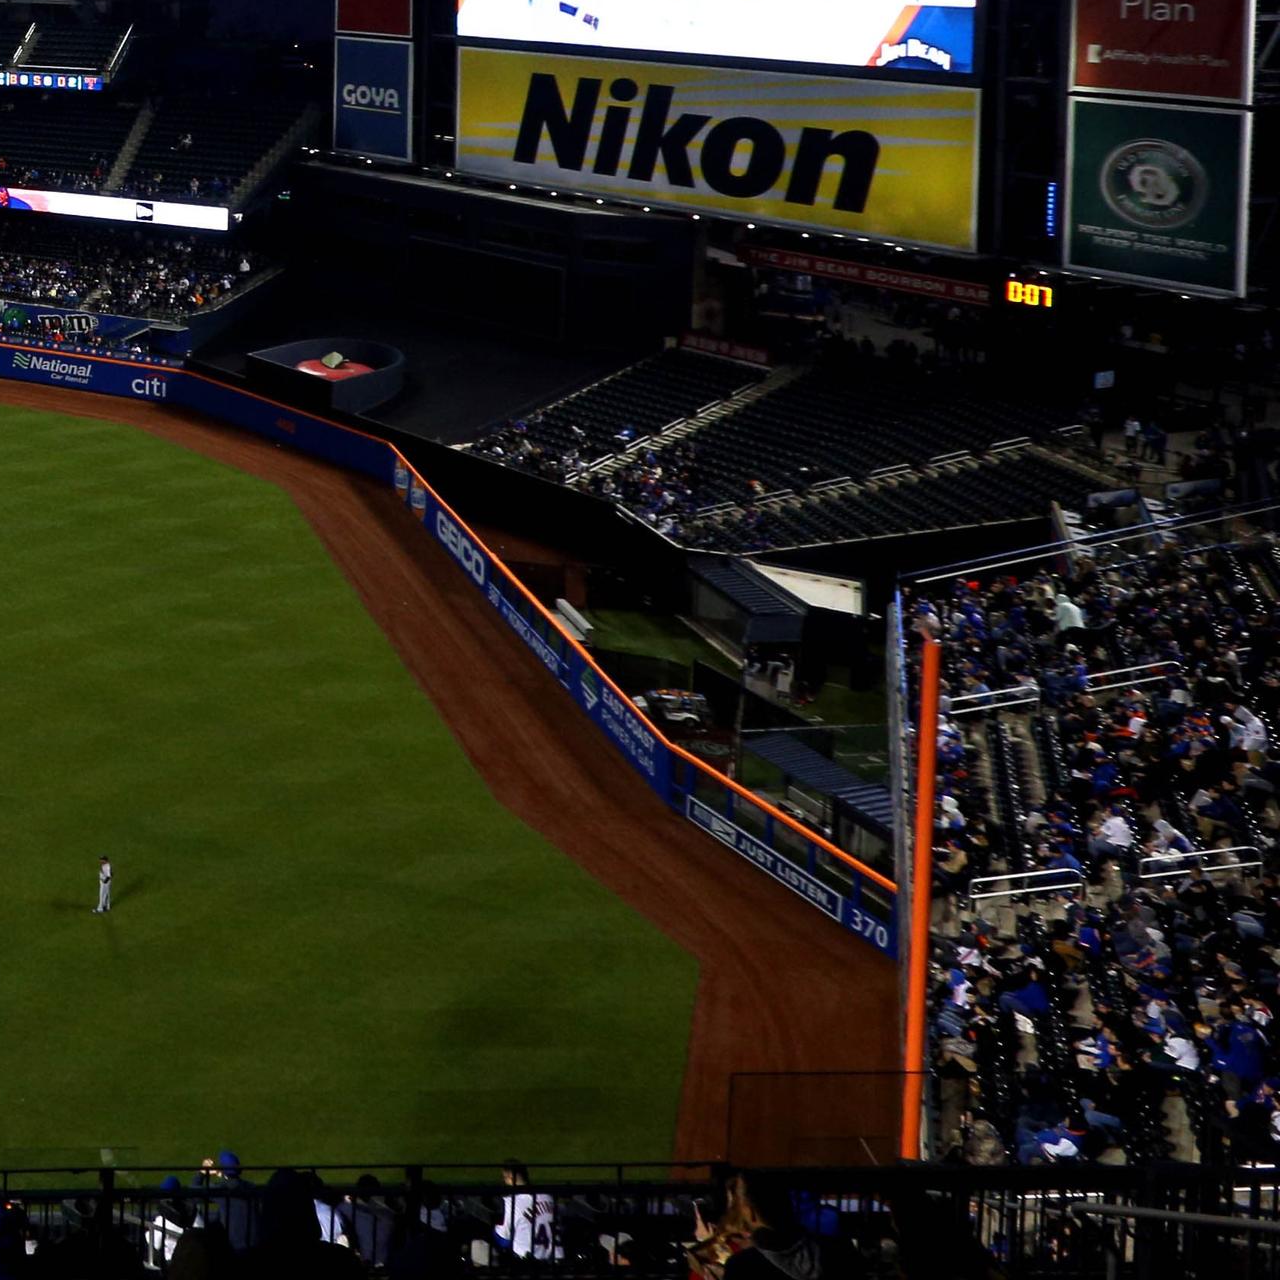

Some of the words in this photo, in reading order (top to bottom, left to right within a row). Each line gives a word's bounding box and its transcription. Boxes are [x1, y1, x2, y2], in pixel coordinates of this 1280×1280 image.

[343, 84, 400, 108] GOYA
[513, 73, 882, 213] Nikon
[749, 249, 778, 262] THE
[783, 254, 809, 267] JIM
[814, 261, 859, 276] BEAM
[863, 270, 943, 291] BOURBON
[951, 284, 987, 300] BAR
[1007, 281, 1053, 308] 0:07
[30, 357, 92, 378] National
[51, 372, 63, 381] Car
[64, 374, 89, 384] Rental
[132, 377, 167, 398] citi
[437, 510, 485, 586] GEICO
[602, 687, 625, 720] EAST
[851, 907, 889, 949] 370
